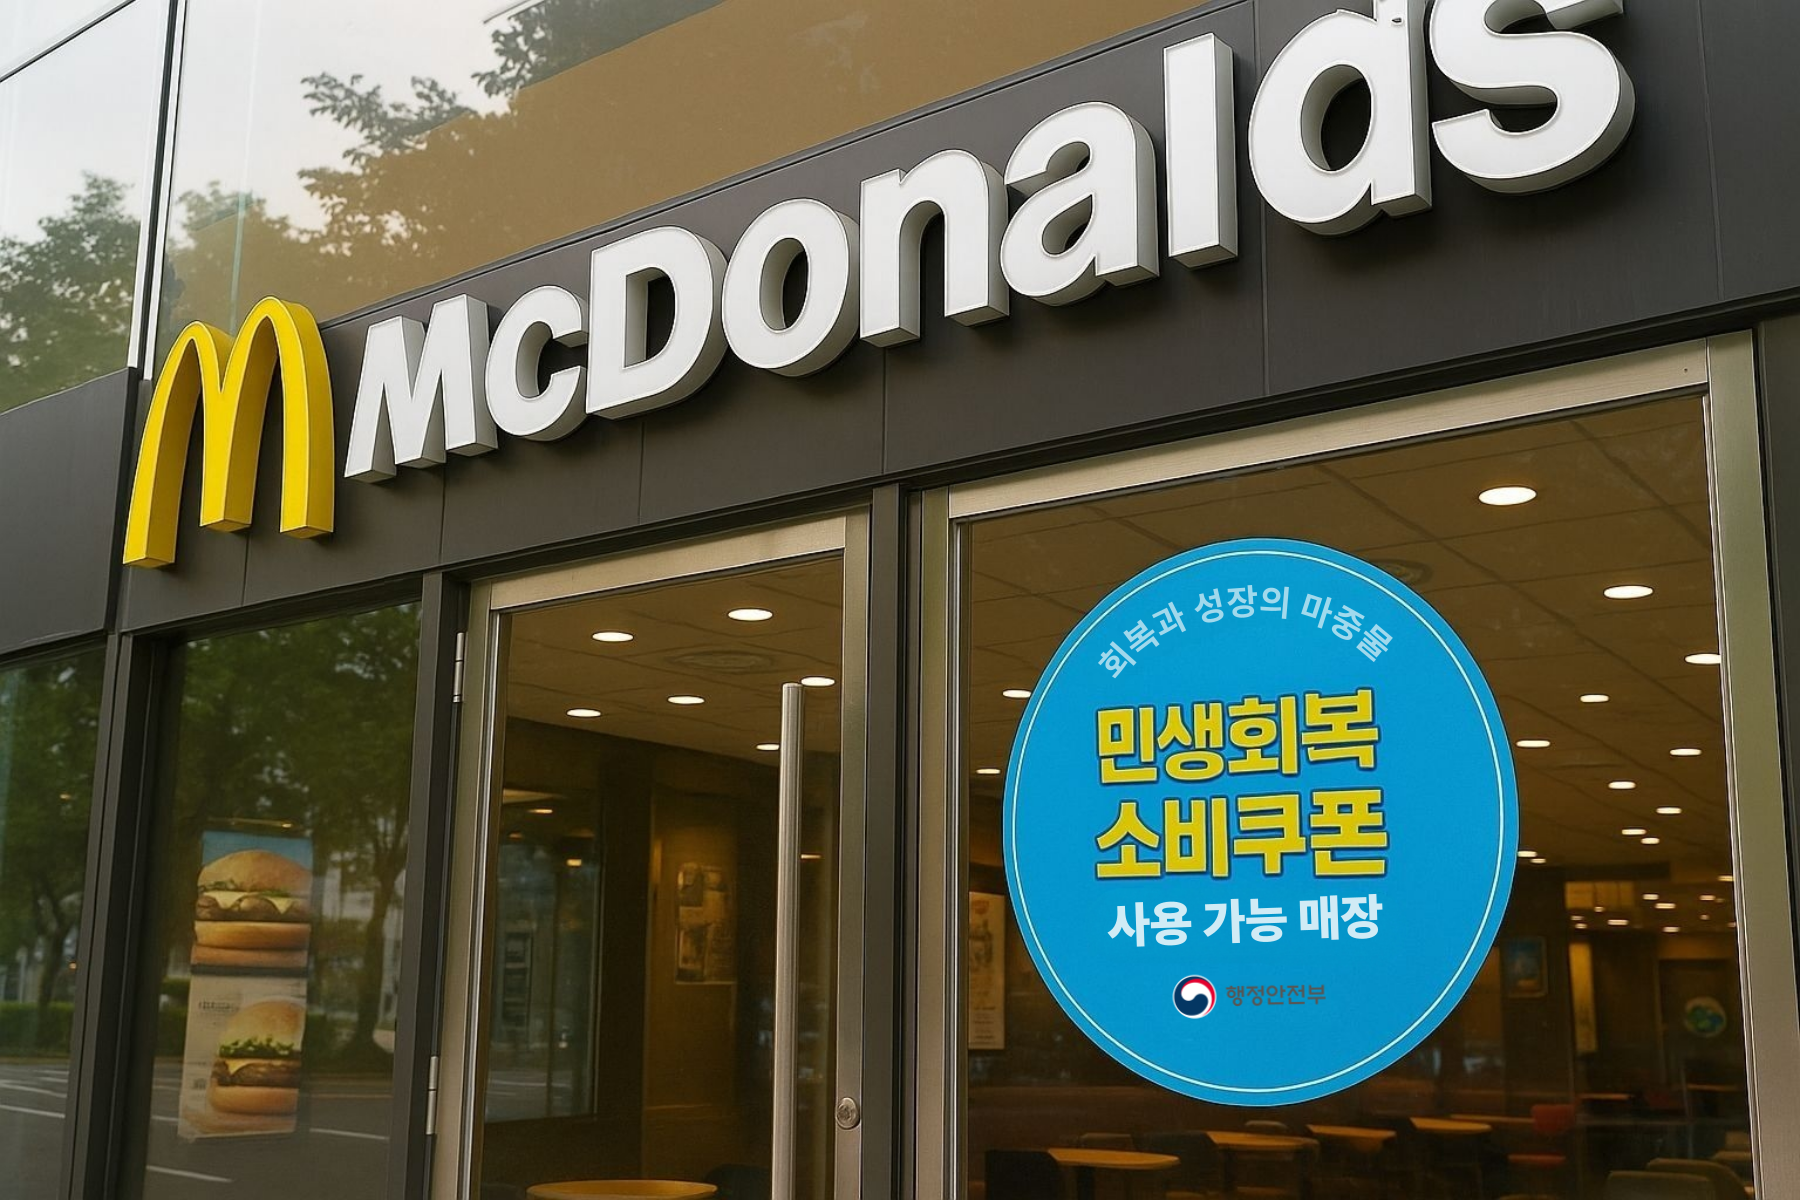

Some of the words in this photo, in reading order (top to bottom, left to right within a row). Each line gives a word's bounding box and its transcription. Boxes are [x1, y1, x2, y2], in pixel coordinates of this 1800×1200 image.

[1098, 601, 1187, 678] 회복과
[1194, 584, 1290, 623] 성장의
[1301, 593, 1394, 662] 마중물
[1096, 687, 1380, 785] 민생회복
[1095, 787, 1389, 879] 소비쿠폰
[1107, 901, 1192, 947] 사용
[1203, 898, 1288, 943] 가능
[1299, 894, 1383, 940] 매장
[1225, 985, 1326, 1006] 행정안전부
